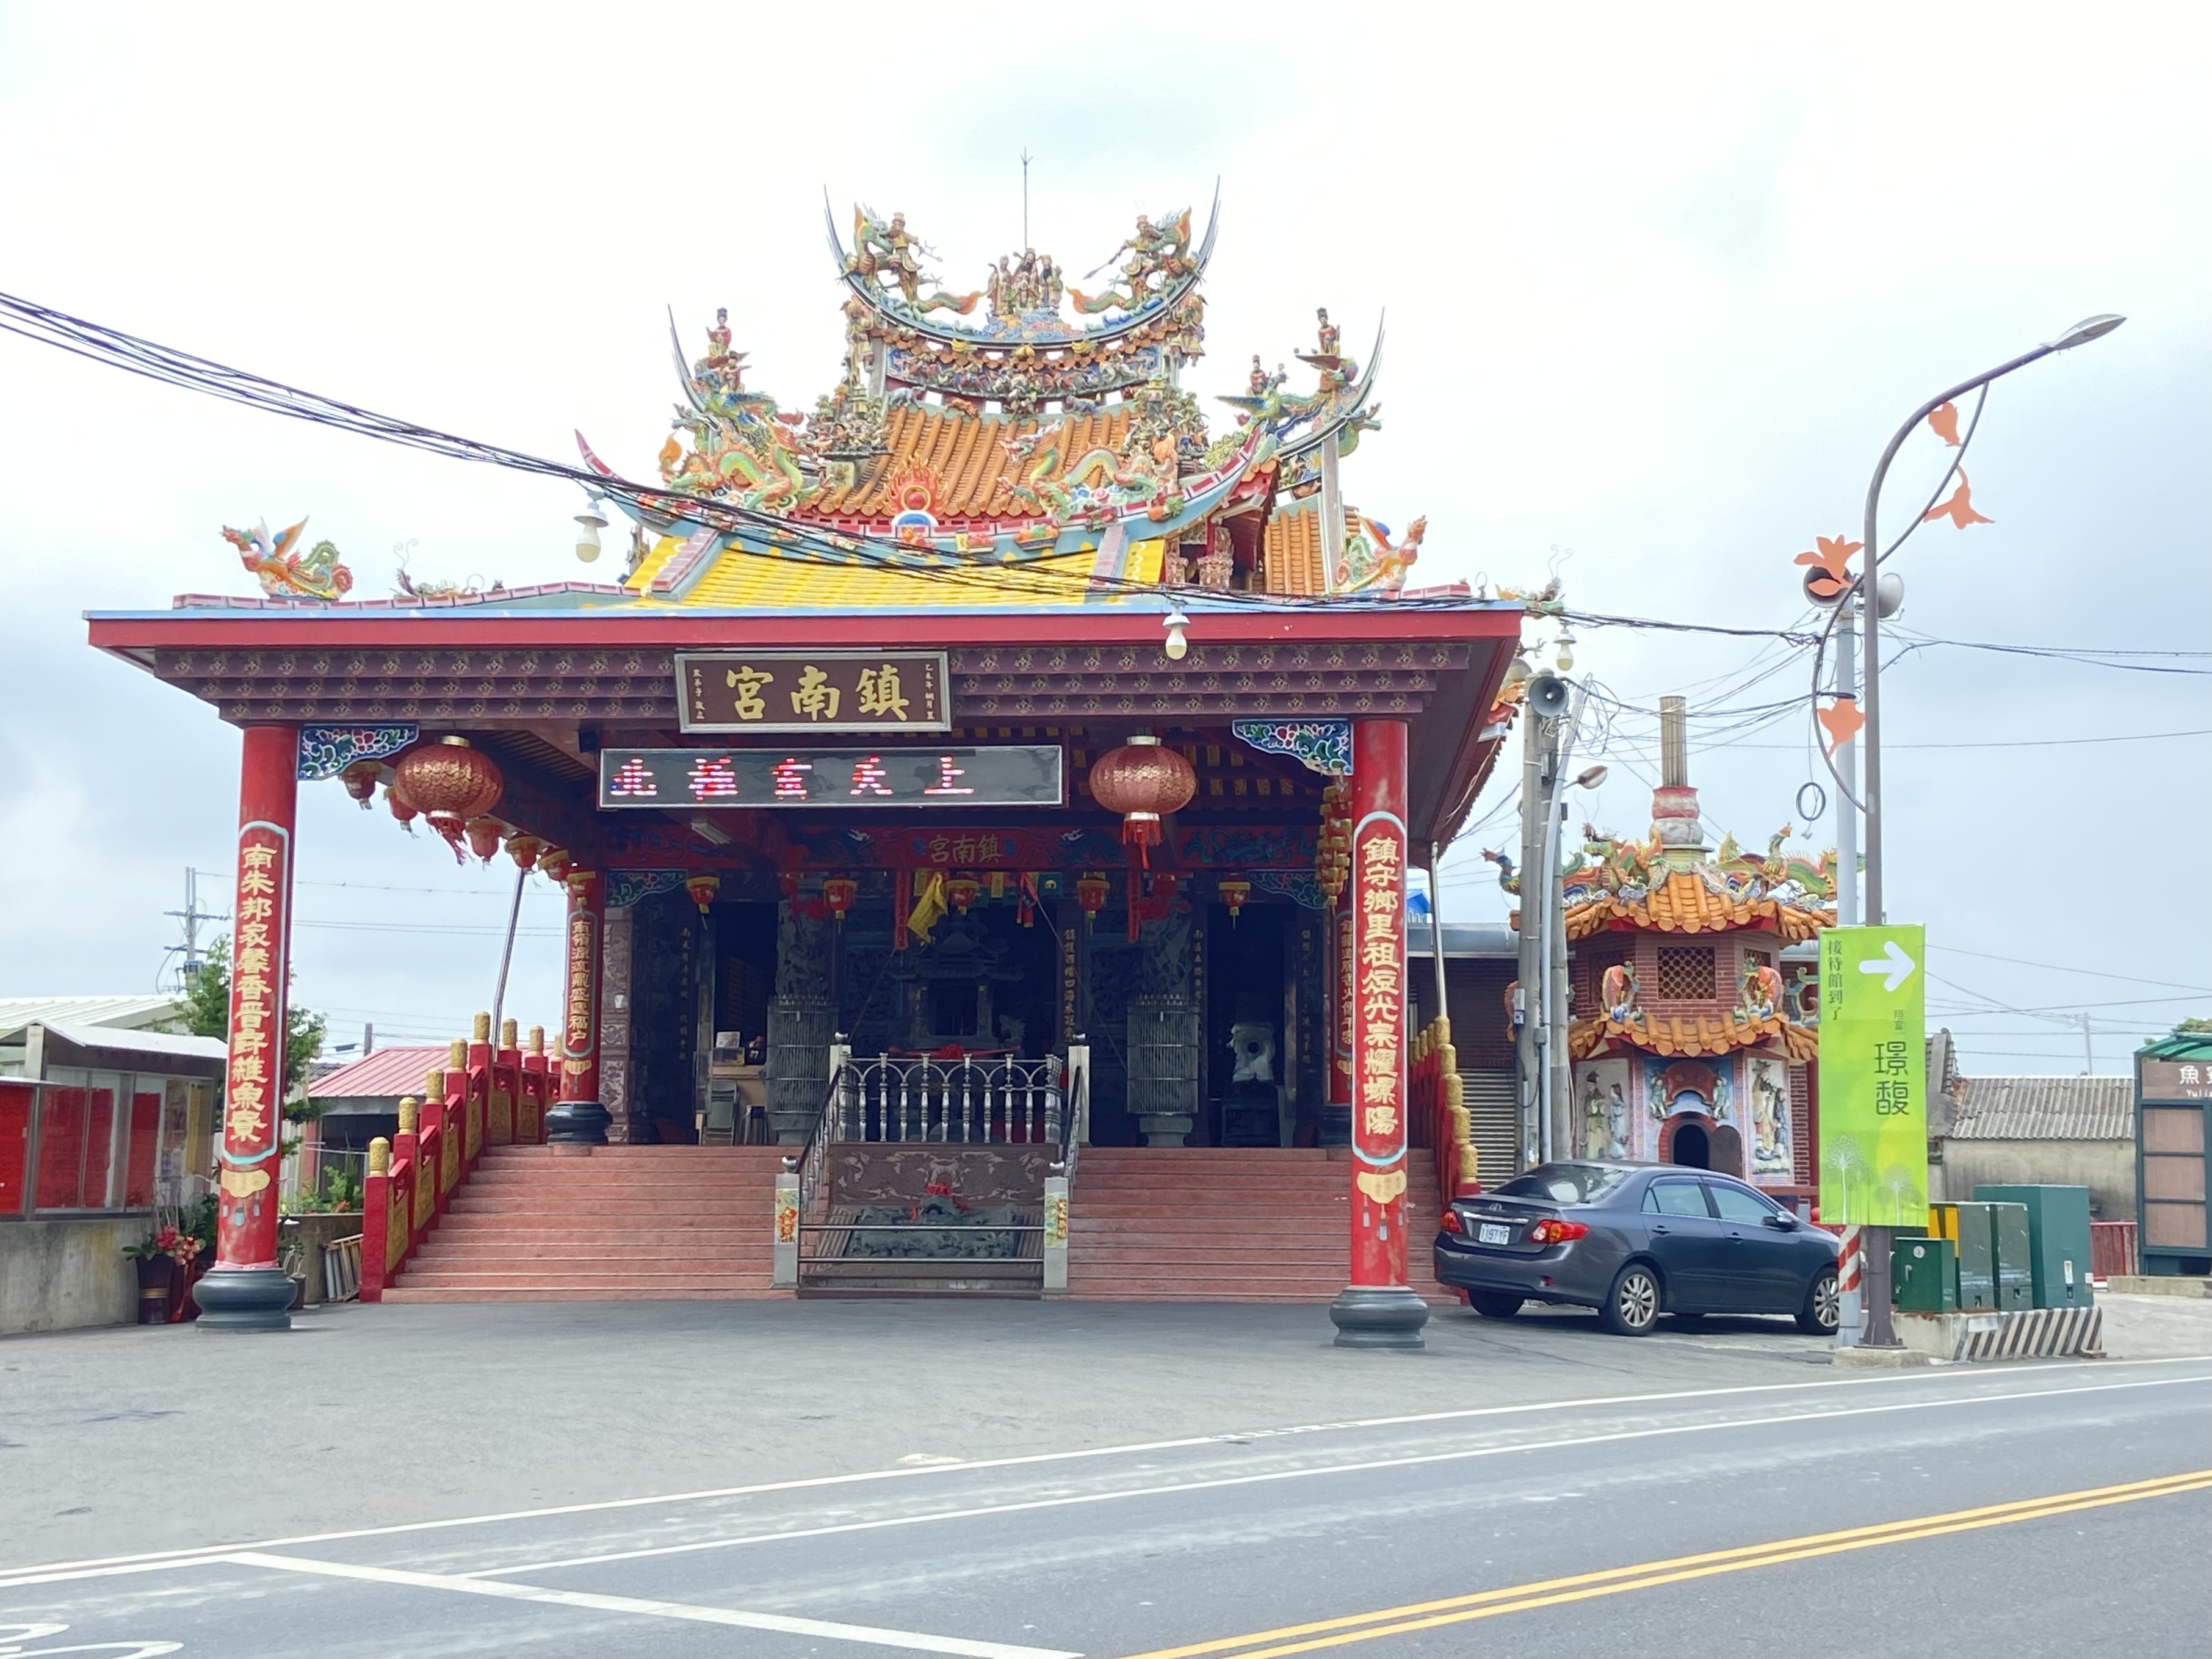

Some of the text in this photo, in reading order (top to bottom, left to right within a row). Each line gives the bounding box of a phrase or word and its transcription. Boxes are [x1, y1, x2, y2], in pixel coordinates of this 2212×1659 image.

[726, 663, 910, 721] 鎮南宮
[928, 834, 1003, 864] 鎮南宮
[1827, 940, 1843, 1021] 接待館到了
[1873, 1041, 1909, 1115] 璟馥
